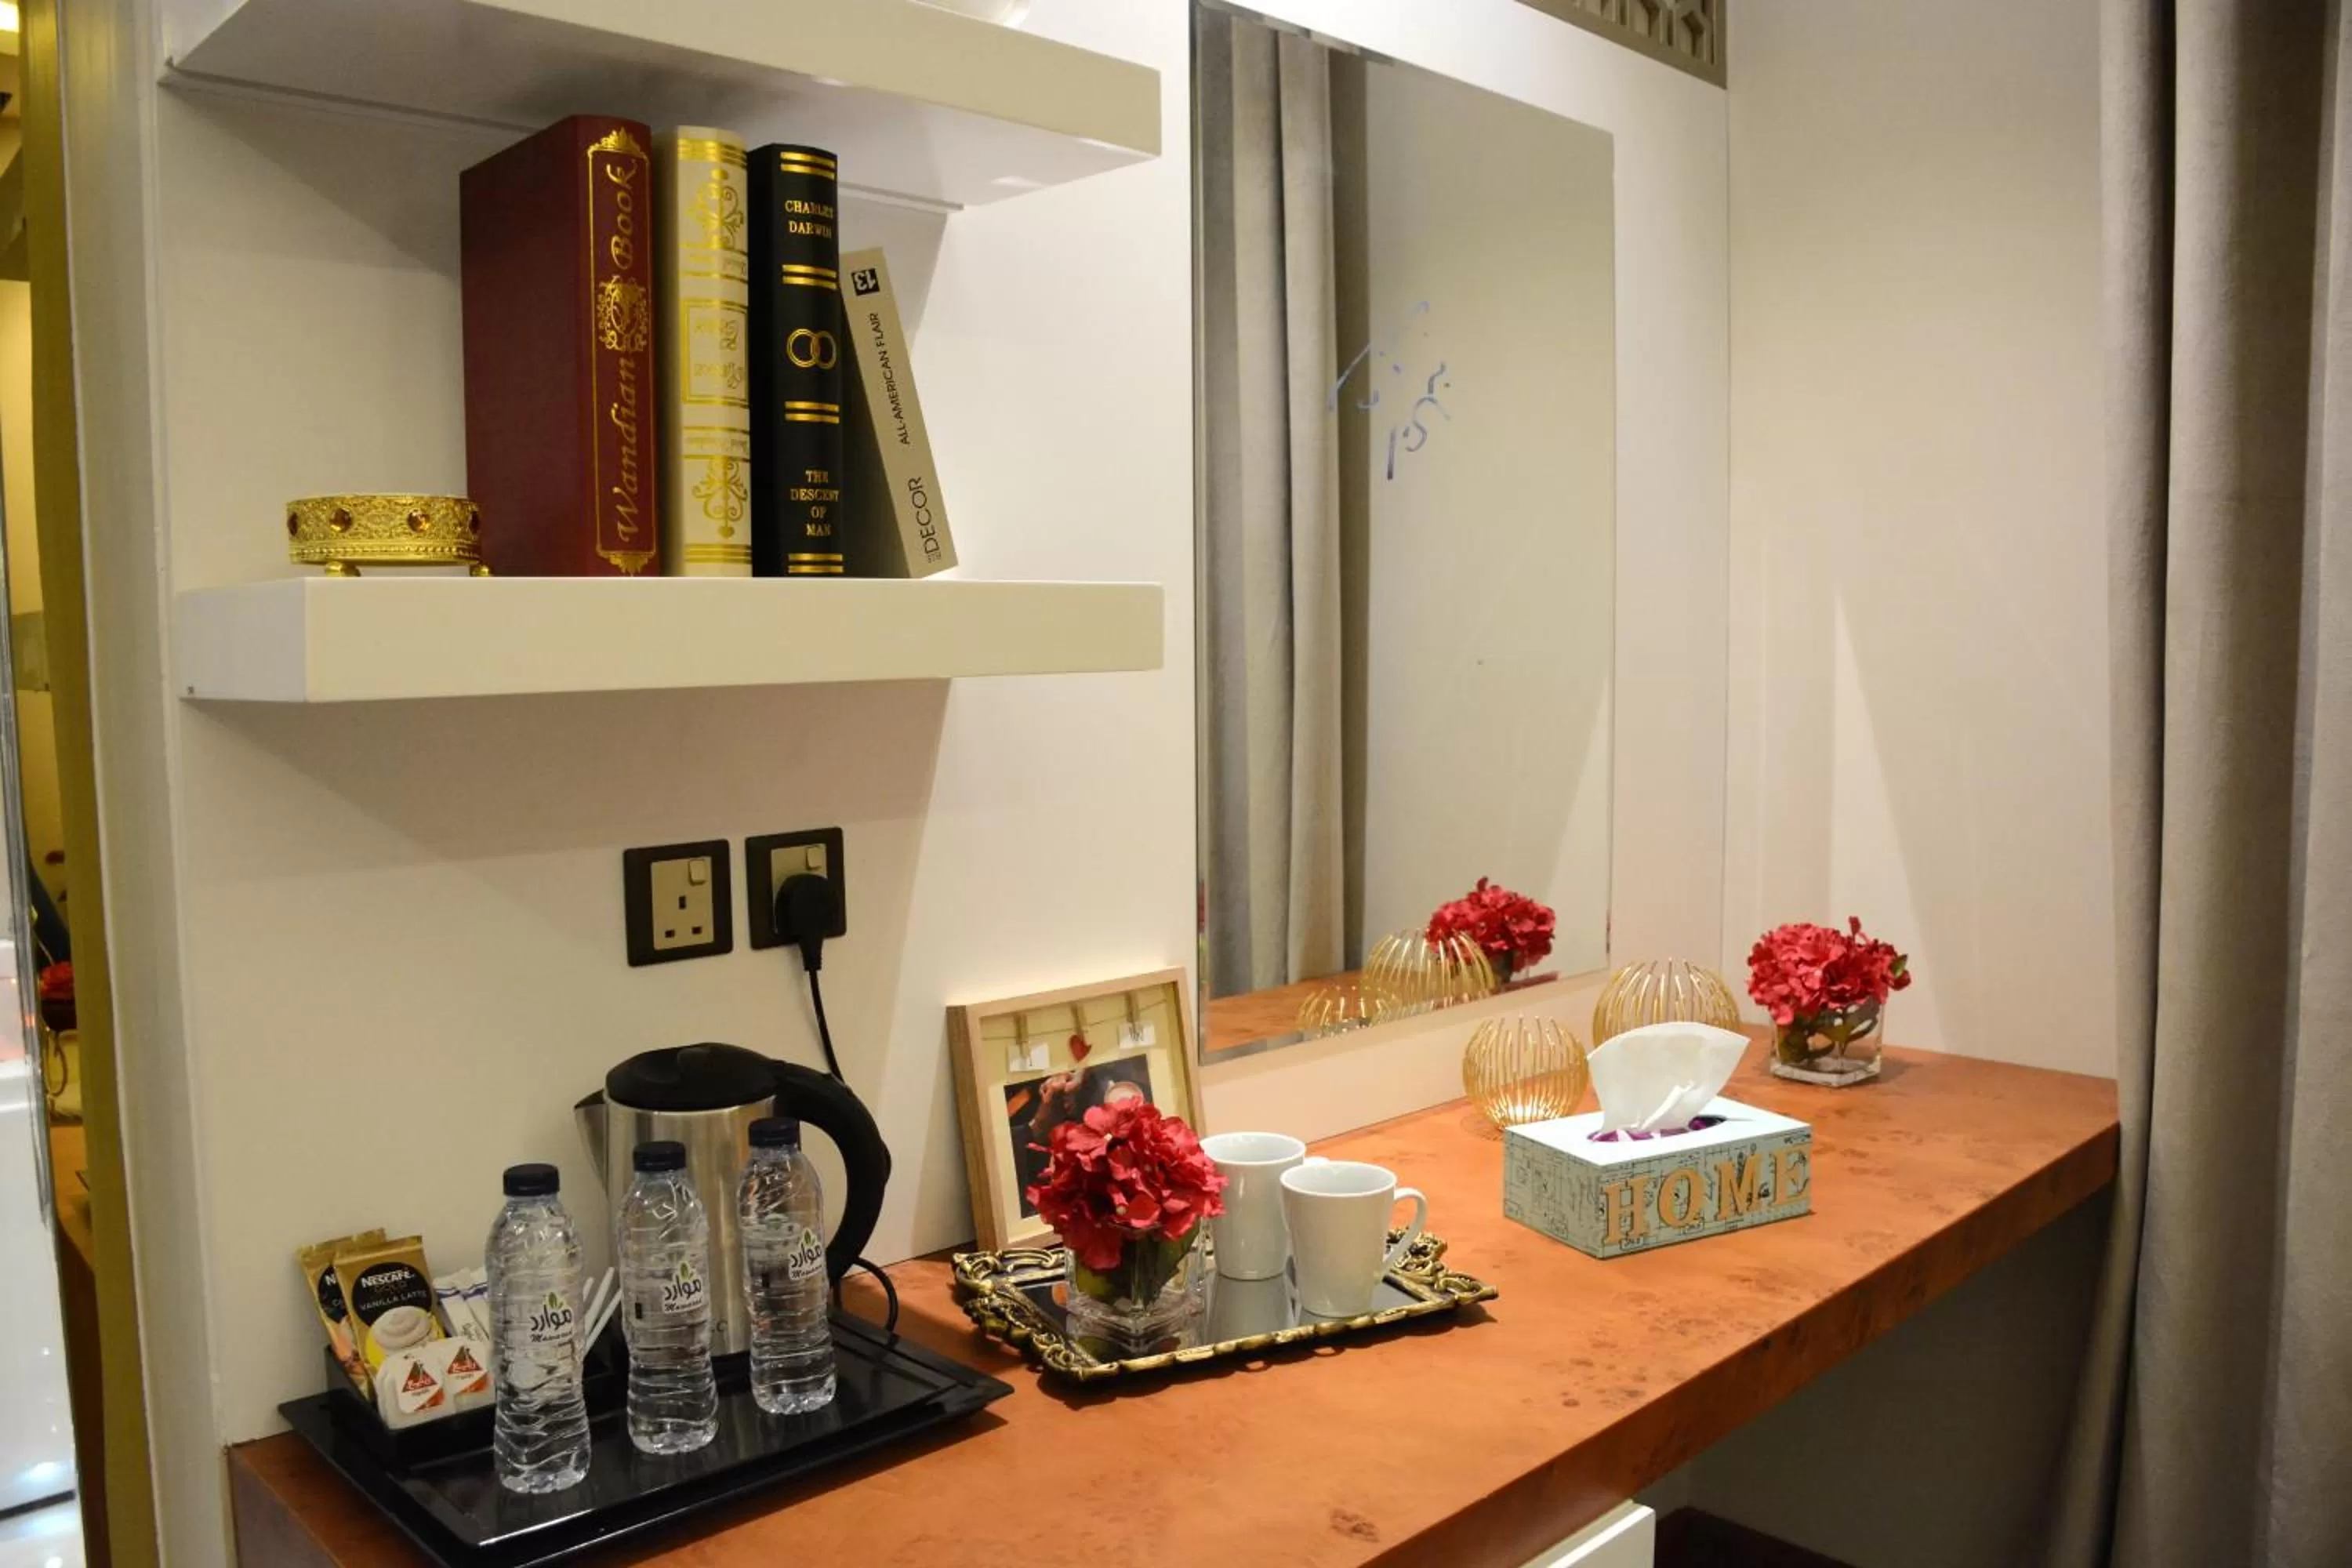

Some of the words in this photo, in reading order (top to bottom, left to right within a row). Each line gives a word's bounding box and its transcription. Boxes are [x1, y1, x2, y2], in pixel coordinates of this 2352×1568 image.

[606, 158, 638, 270] Book
[854, 271, 877, 291] 13
[869, 313, 887, 347] FLAIR
[878, 350, 910, 445] ALL-AMERICAN
[805, 470, 829, 483] THE
[811, 506, 827, 519] OF
[908, 476, 940, 554] DECOR
[806, 523, 831, 536] MAN
[1602, 1144, 1812, 1244] HOME
[663, 1275, 702, 1301] موارد
[529, 1304, 572, 1331] موارد
